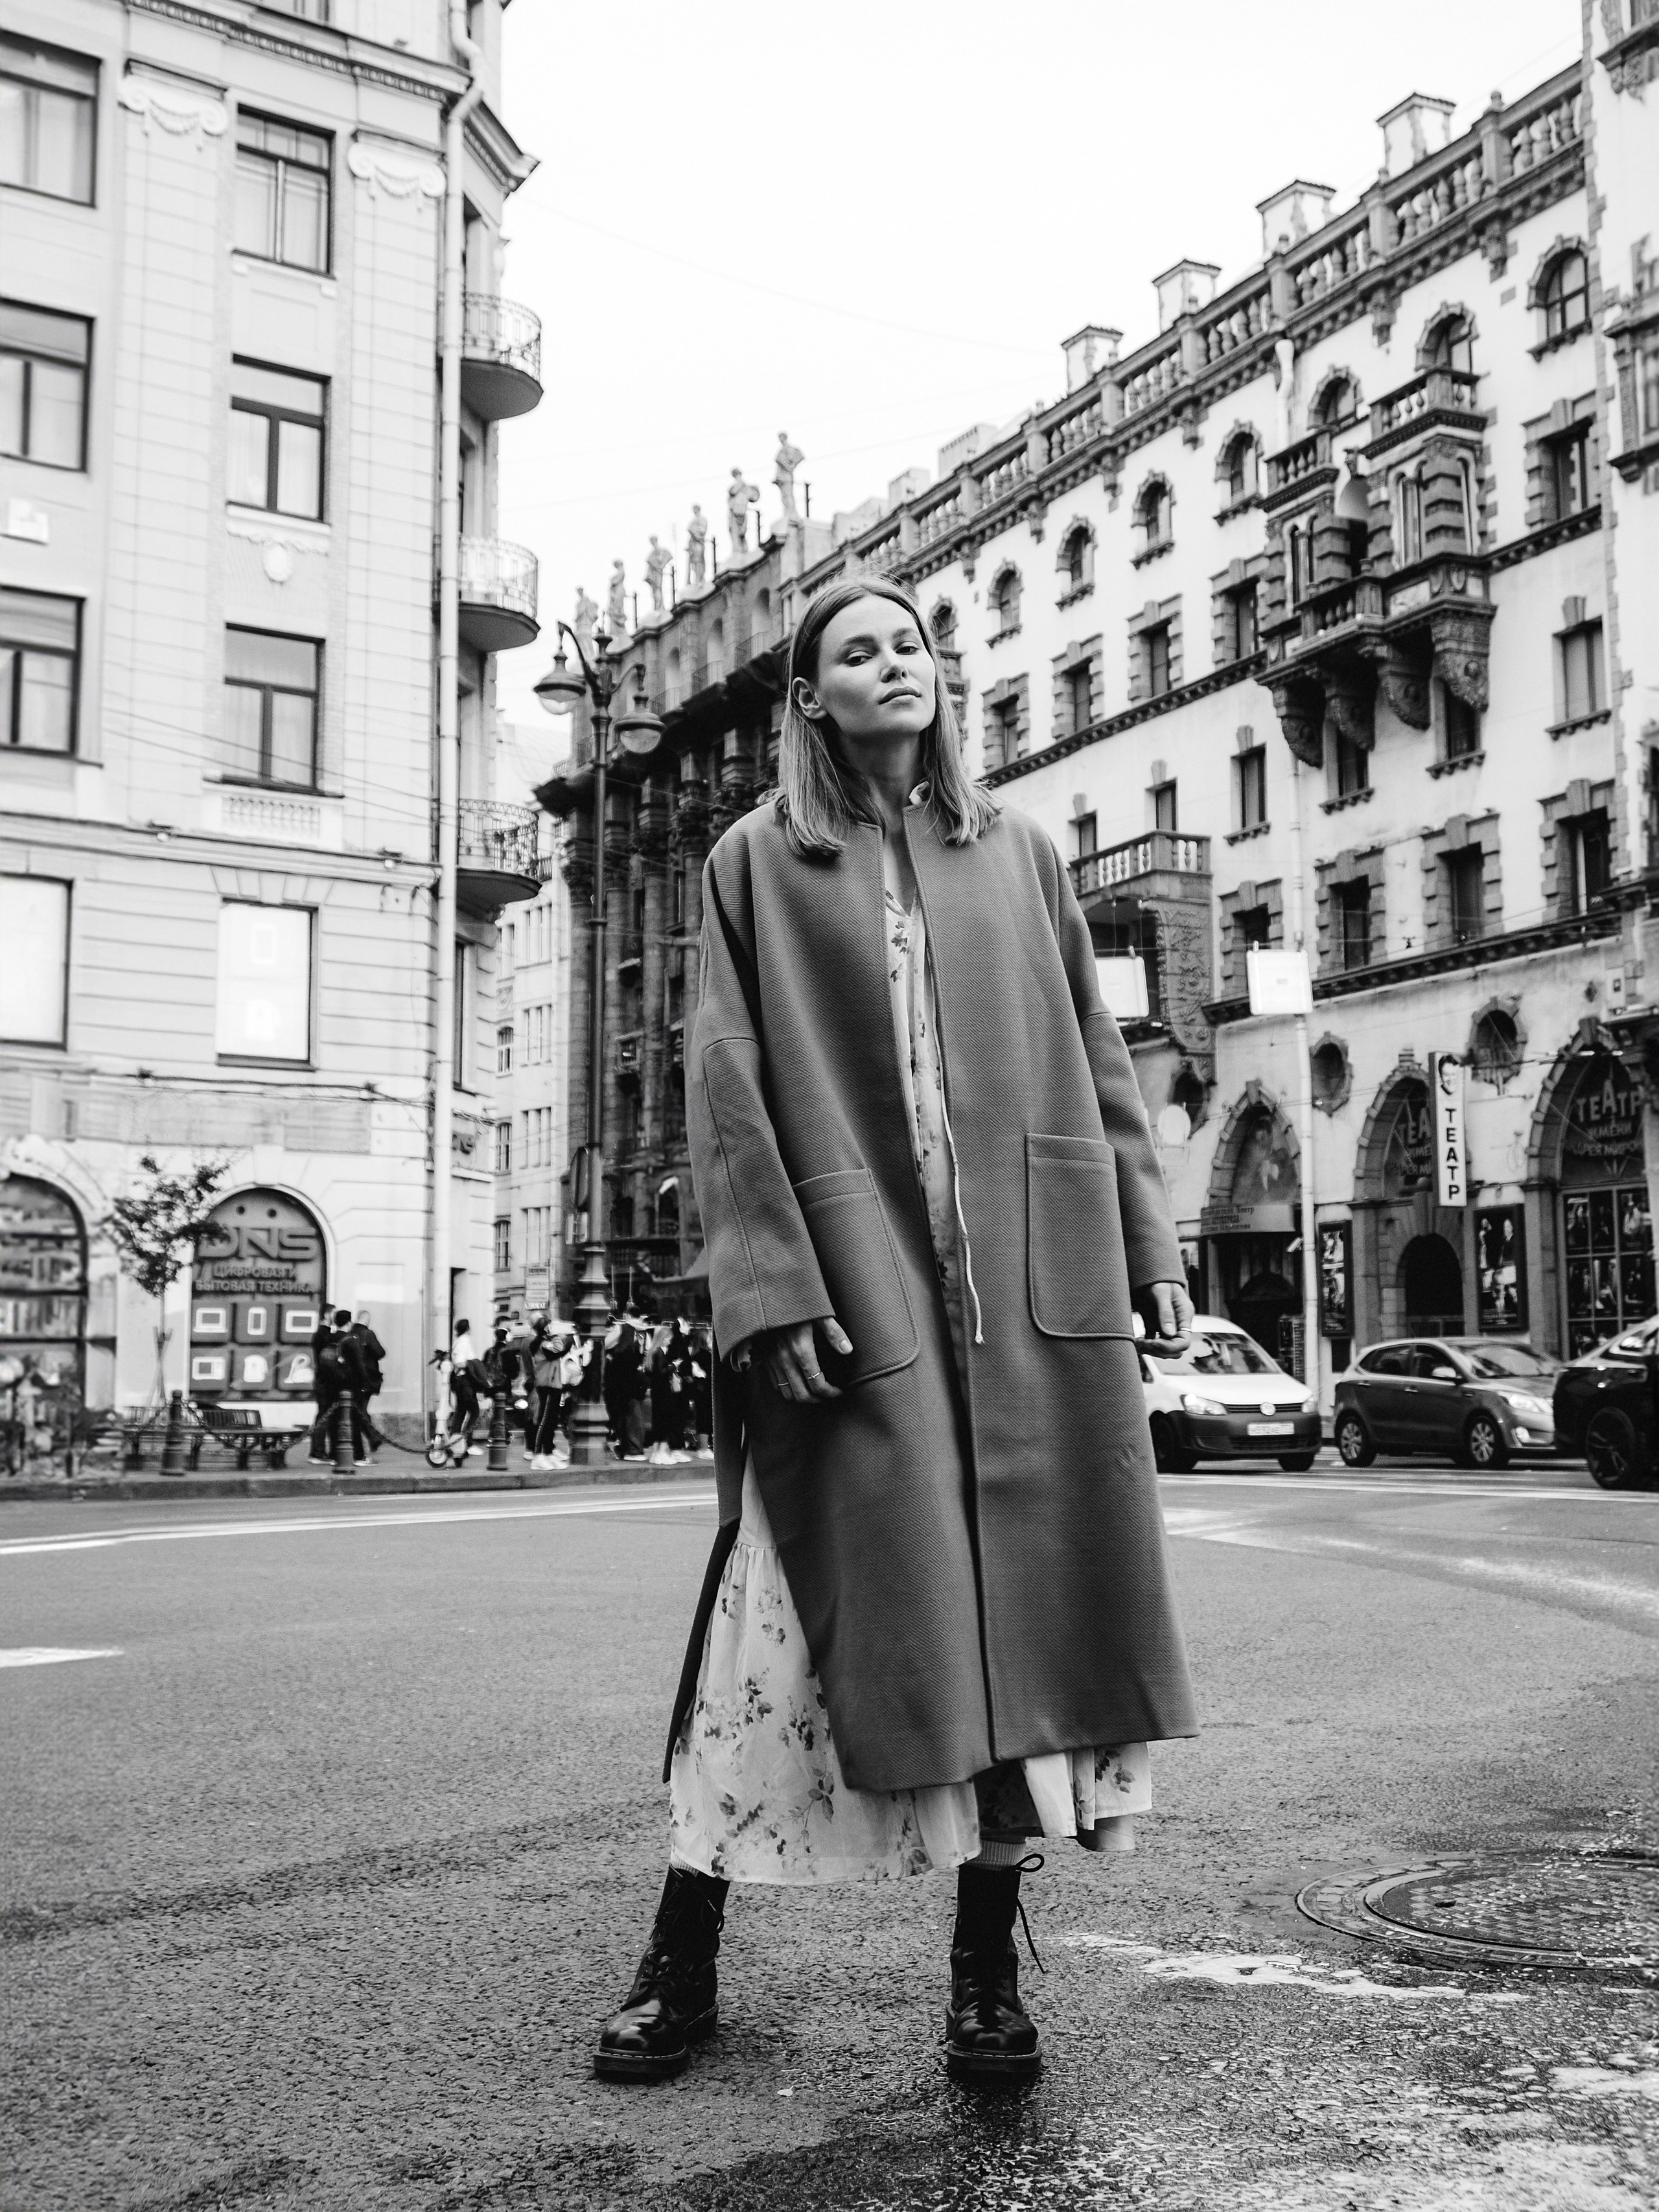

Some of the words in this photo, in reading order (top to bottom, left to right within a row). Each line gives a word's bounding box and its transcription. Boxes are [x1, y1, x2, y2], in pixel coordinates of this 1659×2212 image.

[1576, 1080, 1643, 1122] ТЕАТР
[1398, 1108, 1431, 1144] ТЕА
[1445, 1108, 1460, 1199] ТЕАТР
[196, 1226, 318, 1259] DNS
[196, 1279, 255, 1291] БЫТОВАЯ
[258, 1280, 315, 1292] ТЕХНИКА
[214, 1264, 287, 1278] ЦИФРОВАЯ
